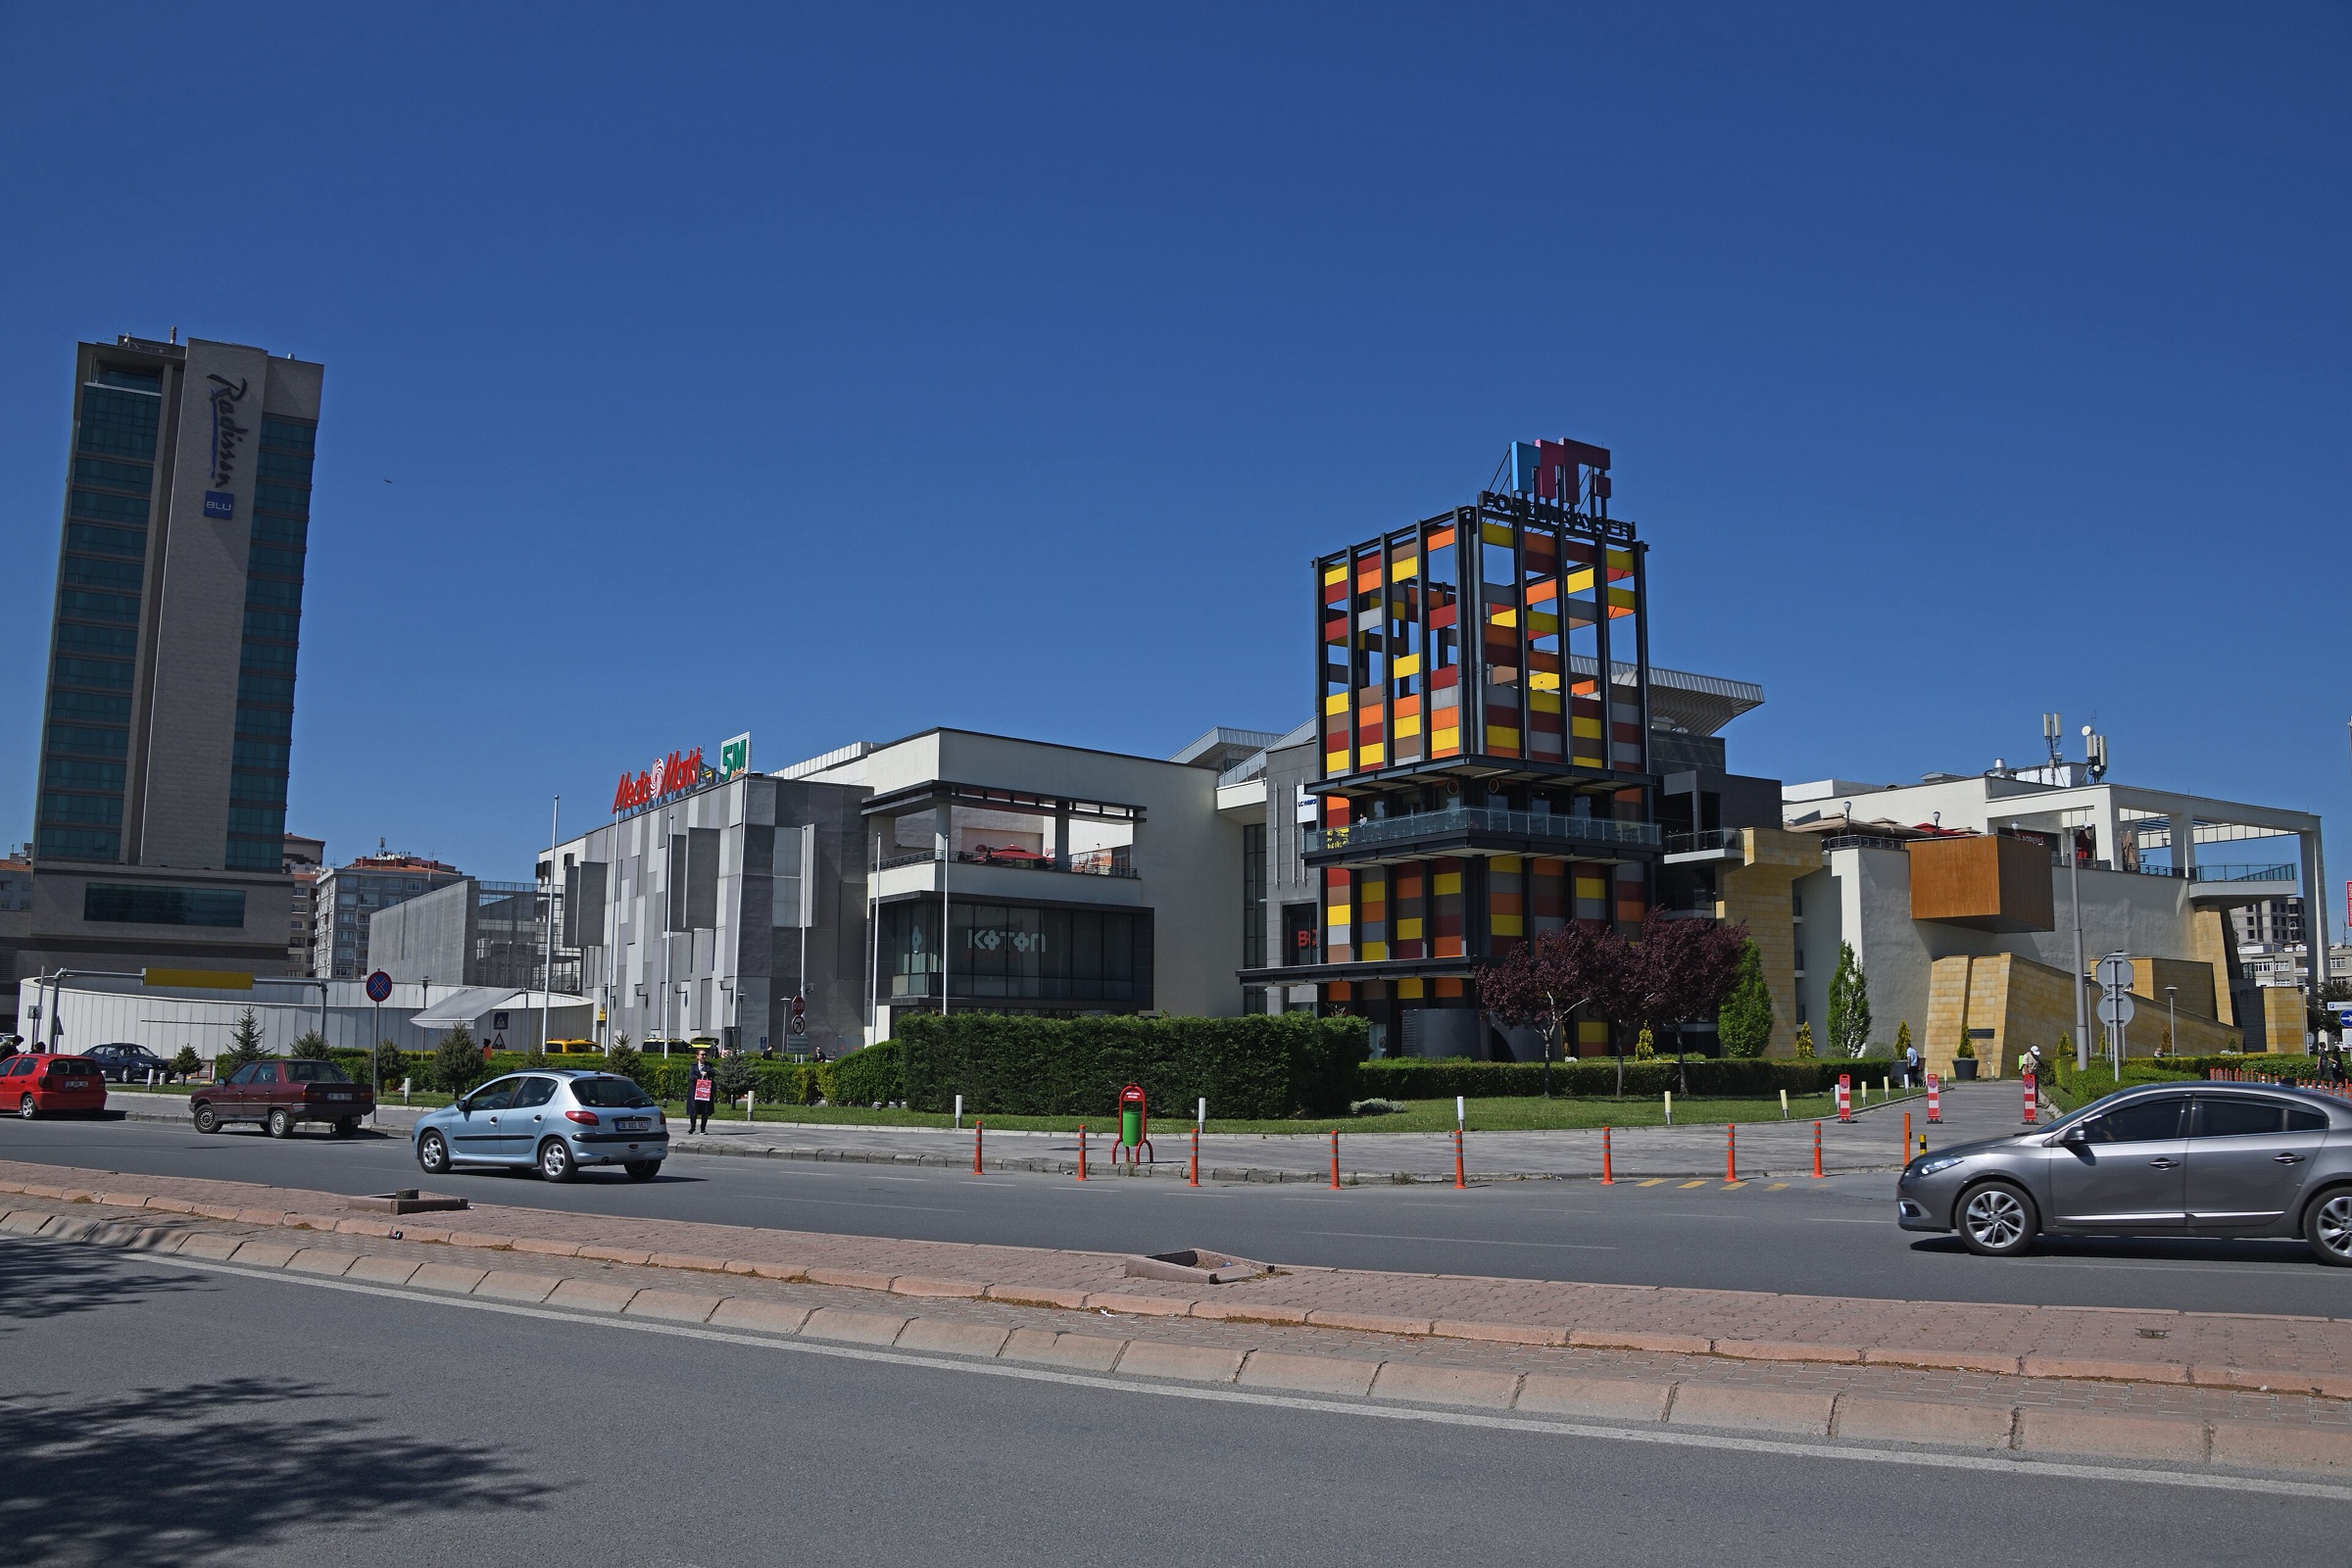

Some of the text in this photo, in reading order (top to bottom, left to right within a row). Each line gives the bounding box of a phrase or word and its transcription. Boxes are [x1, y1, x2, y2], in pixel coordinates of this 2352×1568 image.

[206, 373, 248, 488] Radisson
[206, 501, 232, 513] BLU
[793, 1002, 805, 1010] DUR
